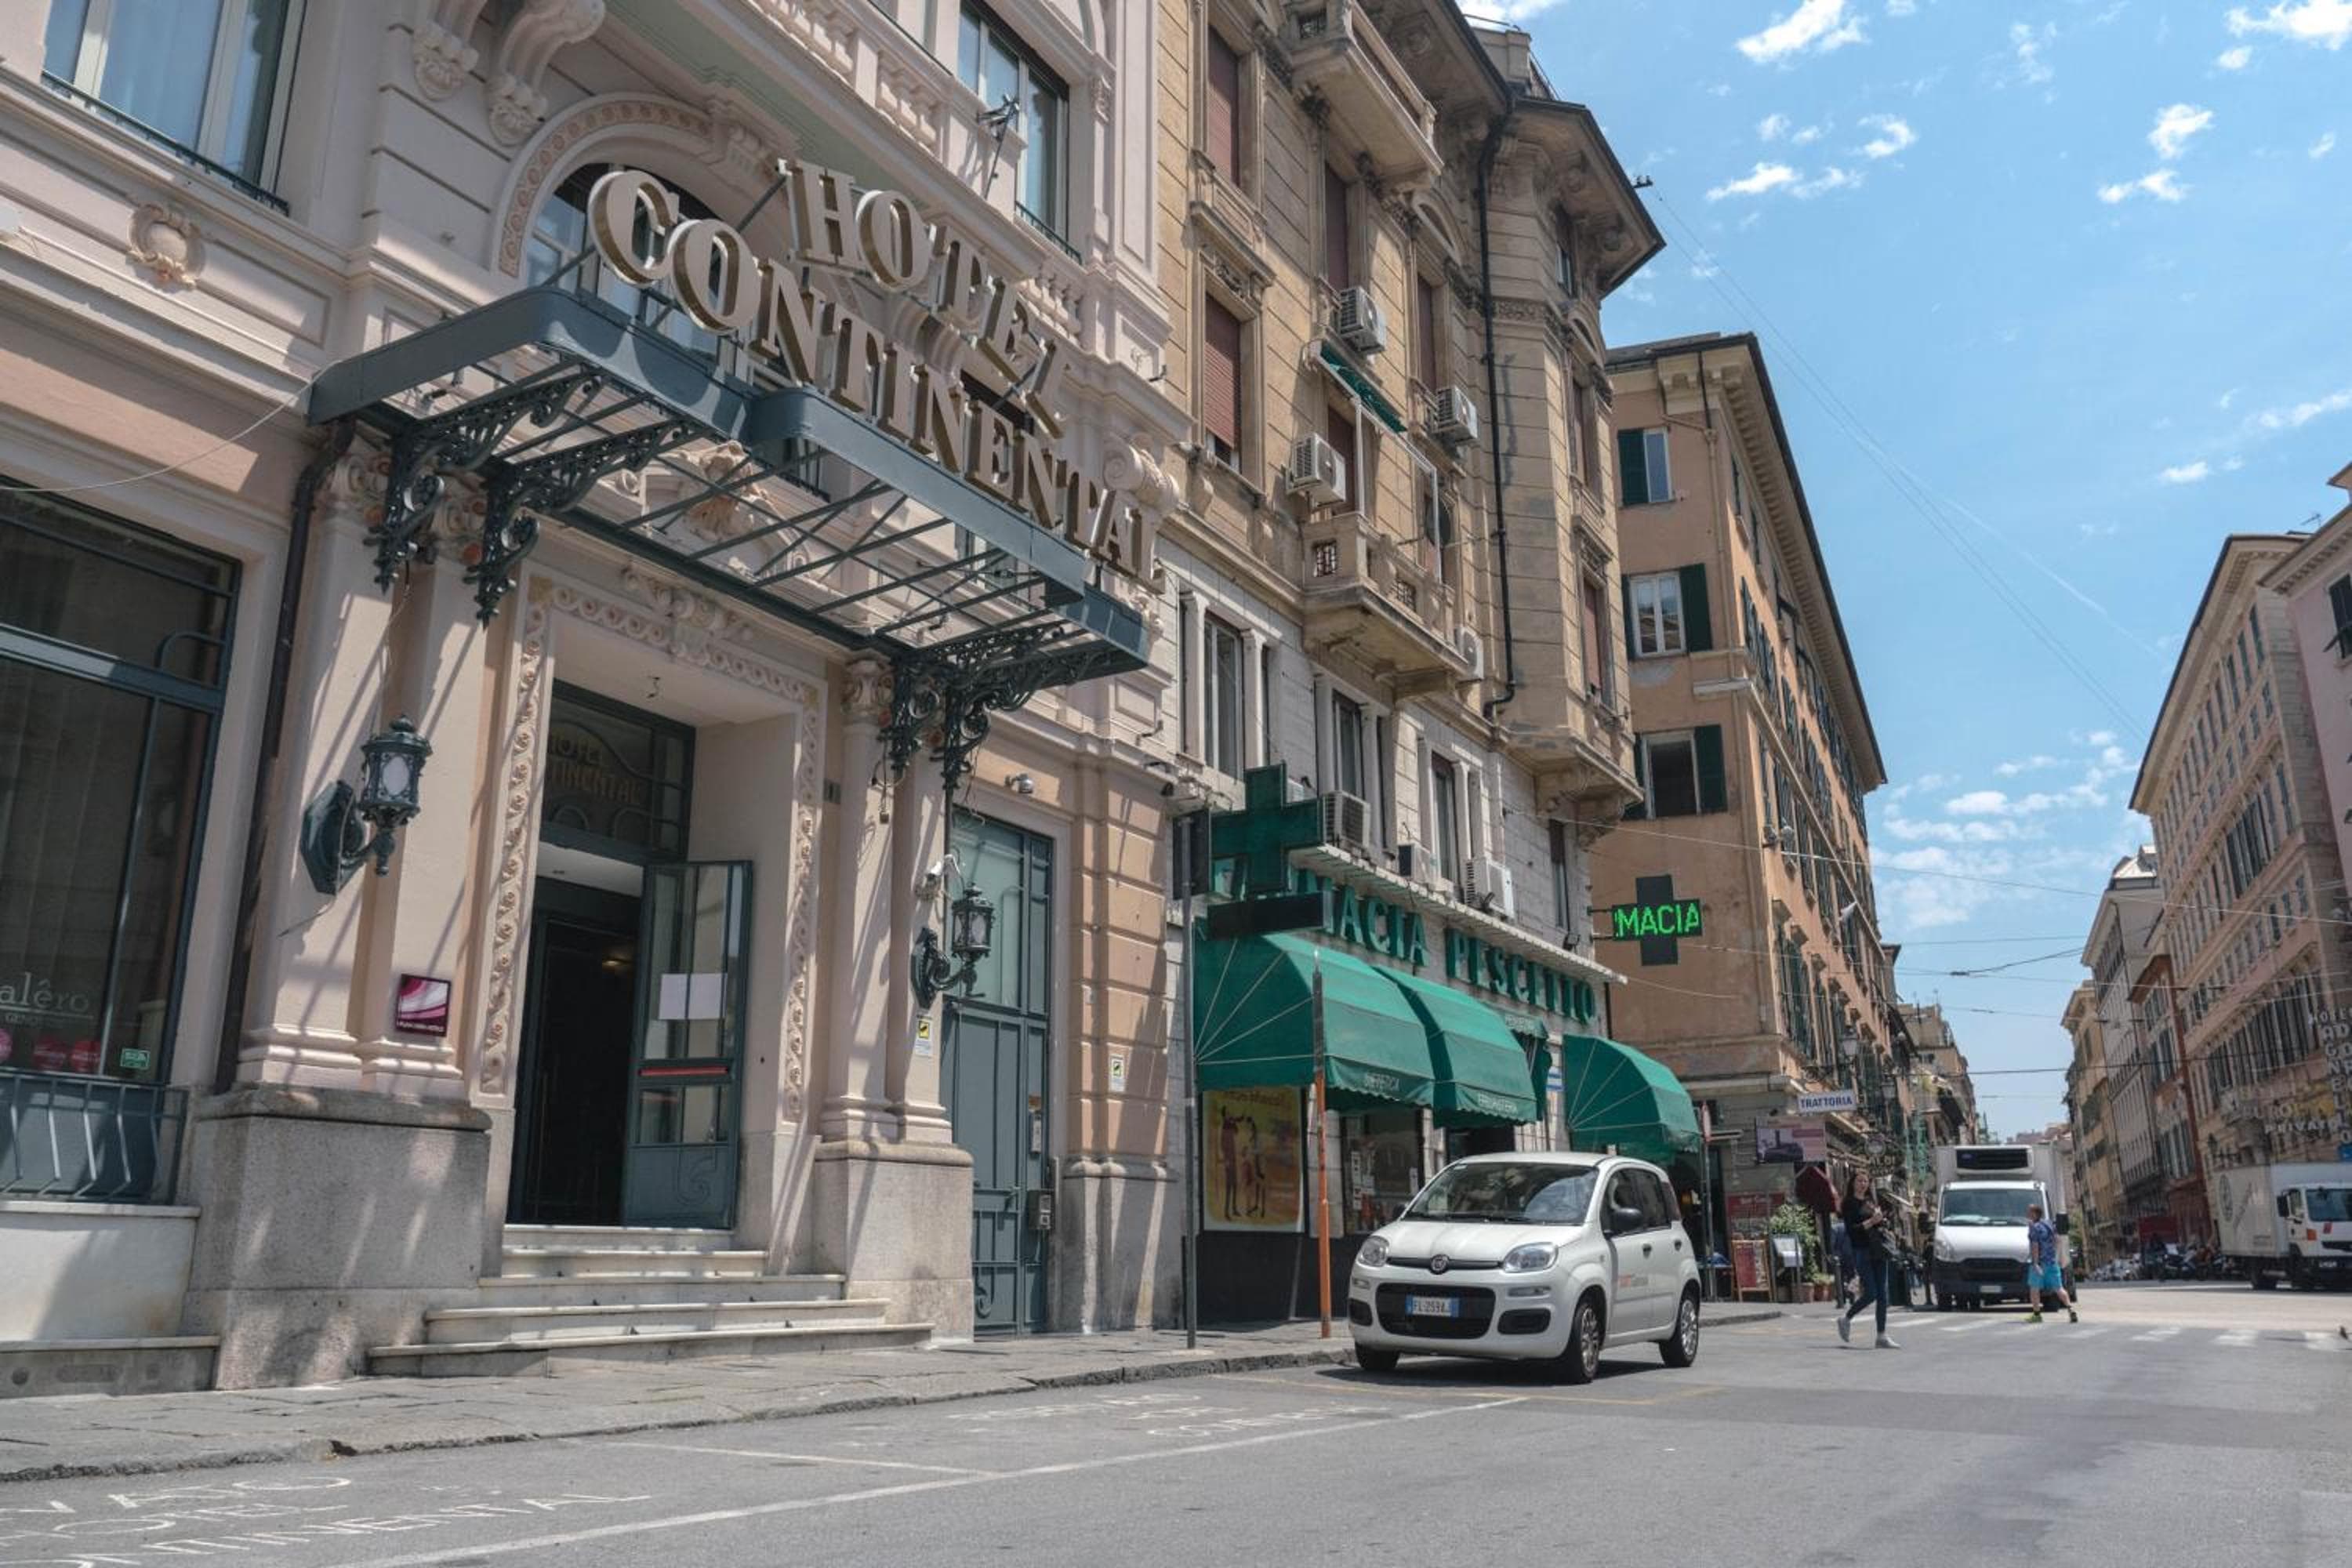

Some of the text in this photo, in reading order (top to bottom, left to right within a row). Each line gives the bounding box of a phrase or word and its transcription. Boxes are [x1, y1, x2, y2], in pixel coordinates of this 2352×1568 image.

[776, 158, 1069, 439] HOTEL
[586, 169, 1166, 596] CONTINENTAL
[1613, 902, 1700, 938] MACIA
[1800, 1094, 1853, 1109] TRATTORIA
